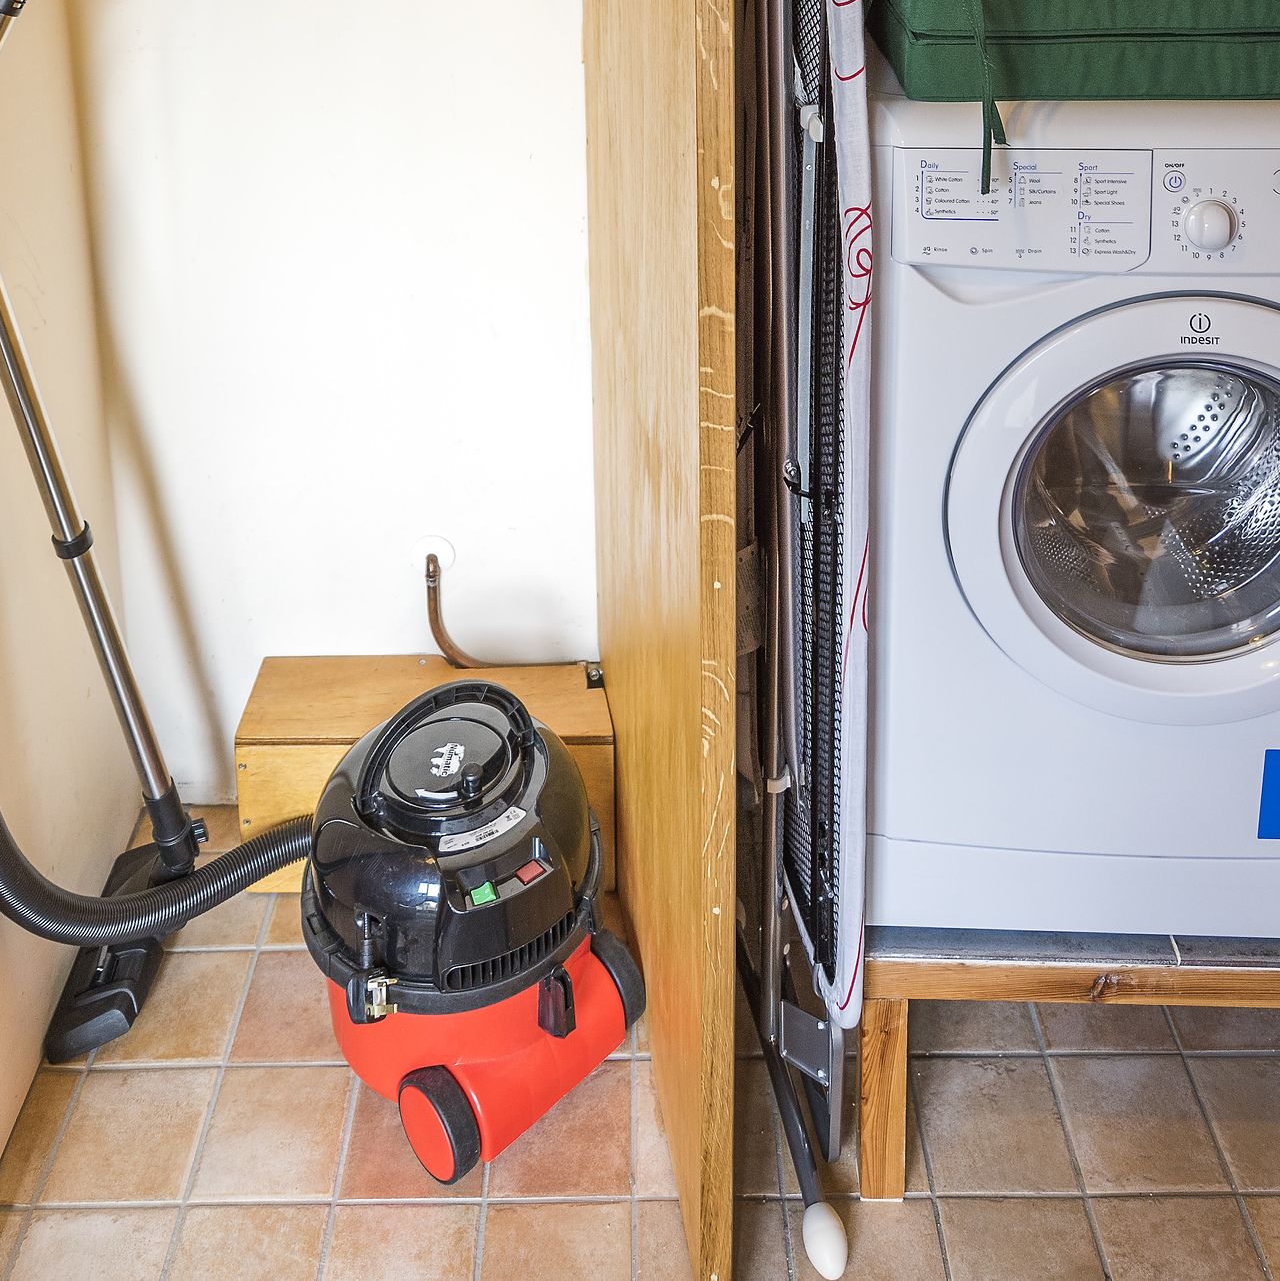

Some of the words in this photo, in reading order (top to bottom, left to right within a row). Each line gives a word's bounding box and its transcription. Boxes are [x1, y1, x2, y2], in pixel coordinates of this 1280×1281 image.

[920, 159, 940, 170] Daily
[1013, 161, 1037, 172] Special
[1078, 162, 1098, 172] Sport
[1078, 211, 1091, 221] Dry
[441, 742, 459, 776] Numatic
